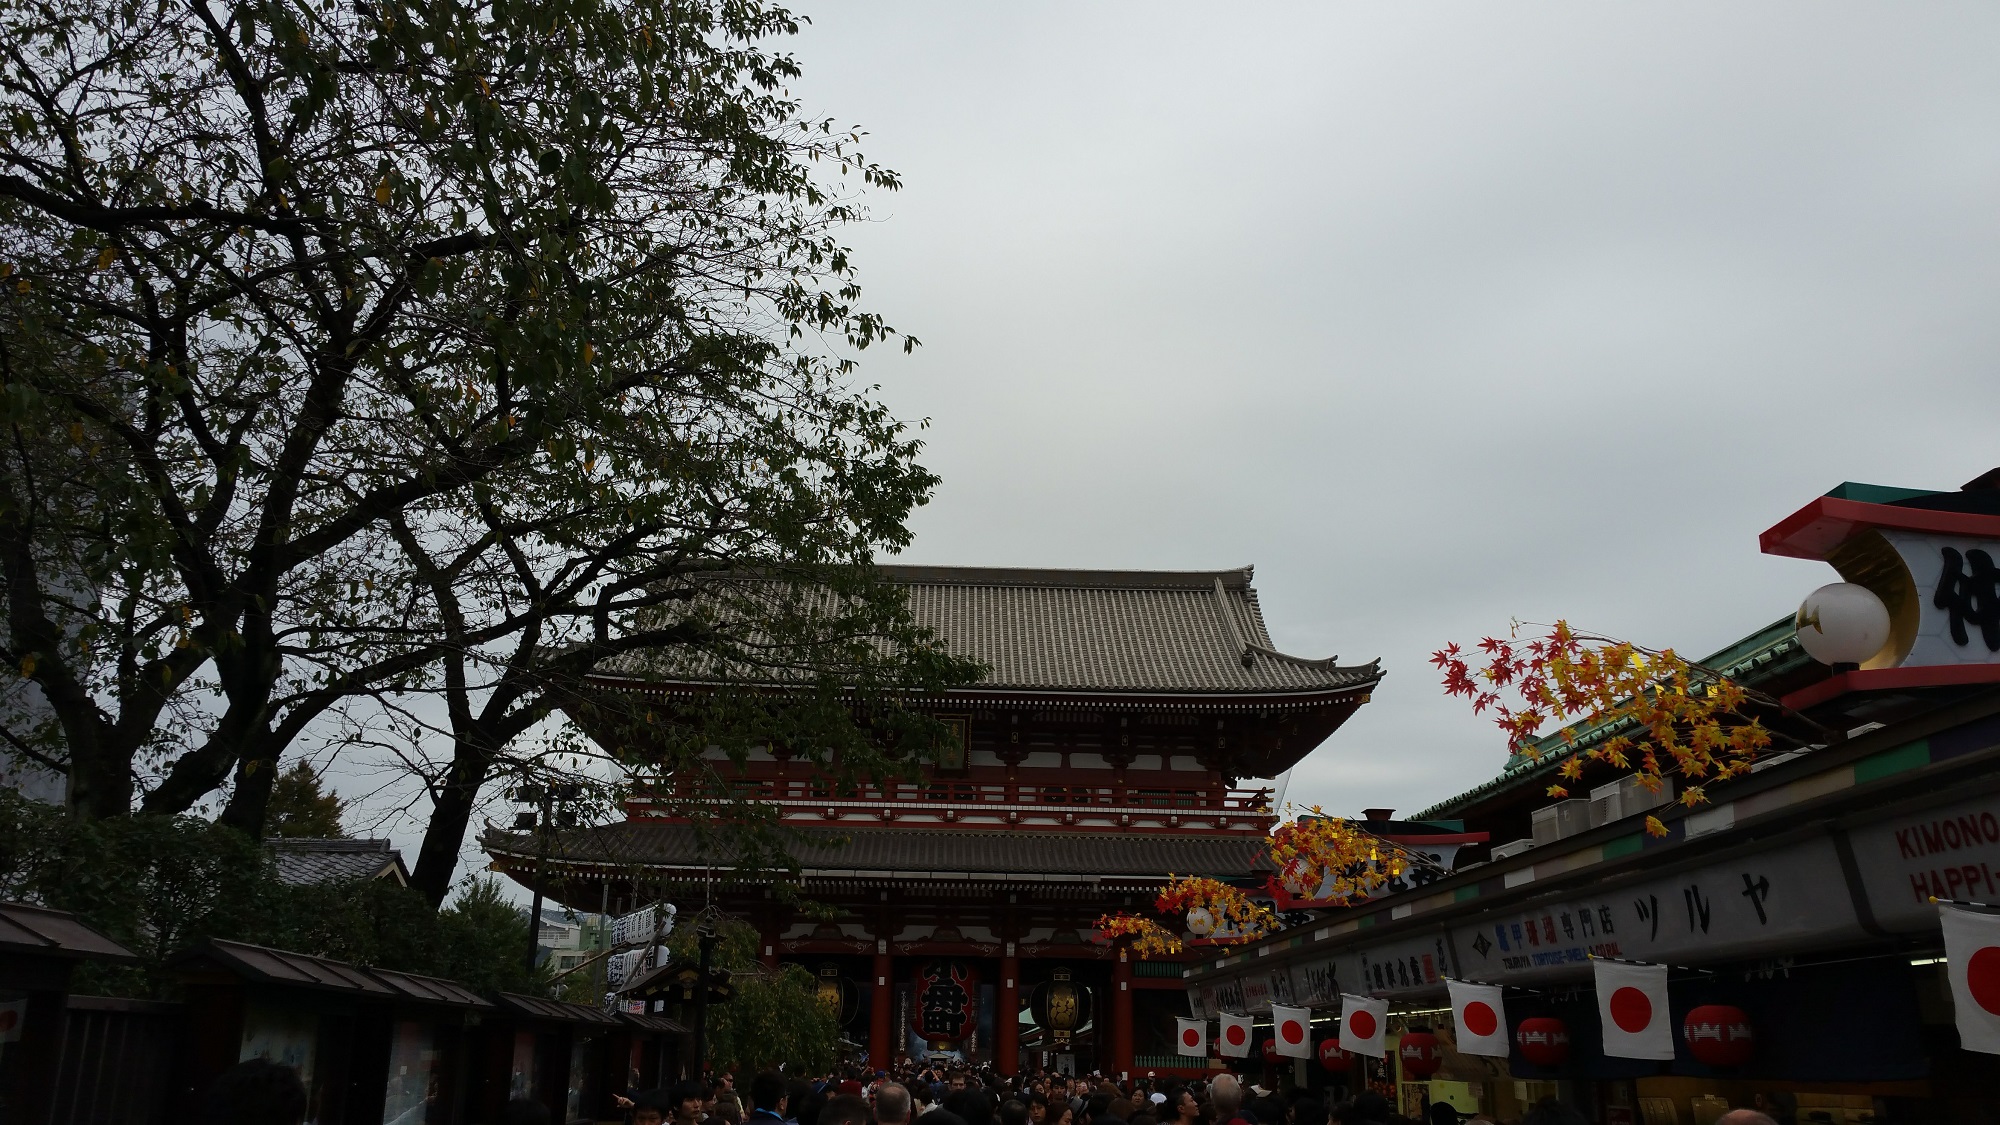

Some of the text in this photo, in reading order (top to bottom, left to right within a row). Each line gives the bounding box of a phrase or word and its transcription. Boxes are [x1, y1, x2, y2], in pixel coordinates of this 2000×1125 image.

[1895, 812, 2000, 859] KIMONO
[1633, 873, 1770, 942] ツルヤ
[1503, 955, 1532, 970] TSURUYA
[1595, 942, 1623, 957] CORAL
